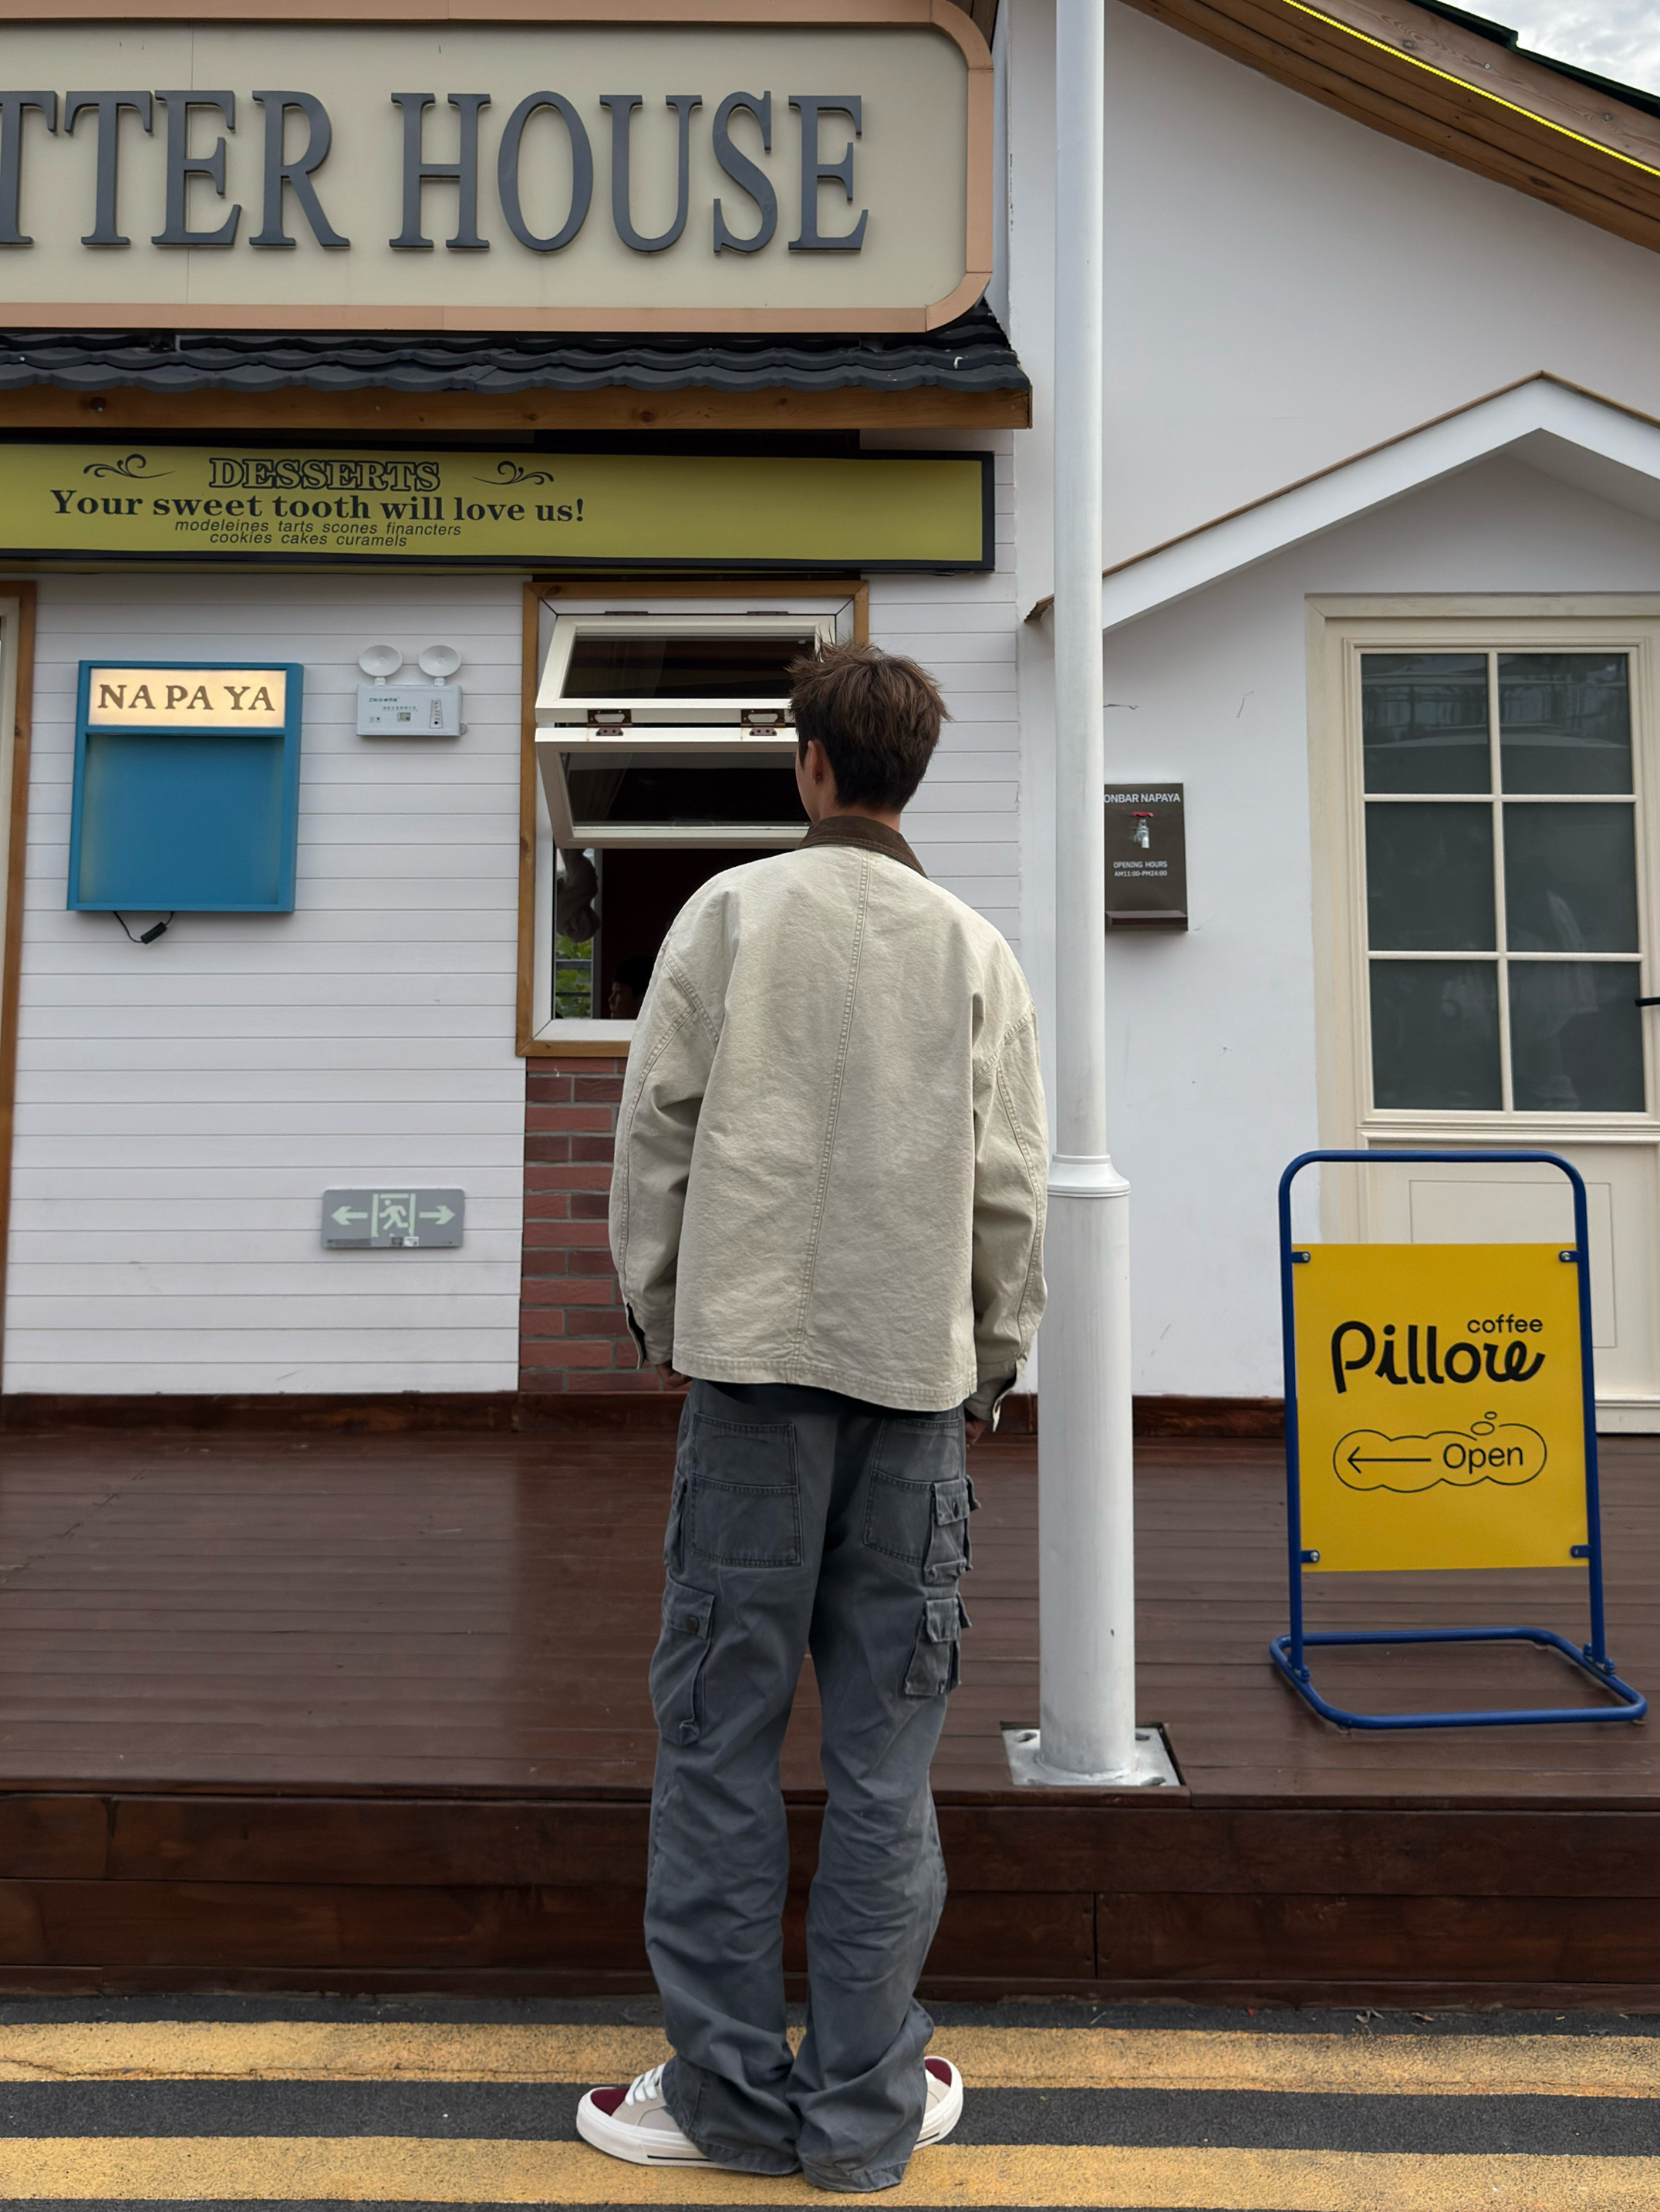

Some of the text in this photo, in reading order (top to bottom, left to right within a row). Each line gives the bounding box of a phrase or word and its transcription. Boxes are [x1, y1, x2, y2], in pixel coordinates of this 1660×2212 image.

[389, 90, 869, 256] HOUSE
[209, 457, 441, 492] DESSERTS
[50, 490, 584, 522] Your sweet tooth will love us!
[174, 519, 269, 532] modeleines
[278, 520, 314, 533] tarts
[322, 524, 378, 534] scones
[210, 530, 407, 547] cookies cakes curamels
[1140, 793, 1181, 803] NAPAYA
[1467, 1313, 1544, 1334] coffee
[1442, 1442, 1524, 1475] Open
